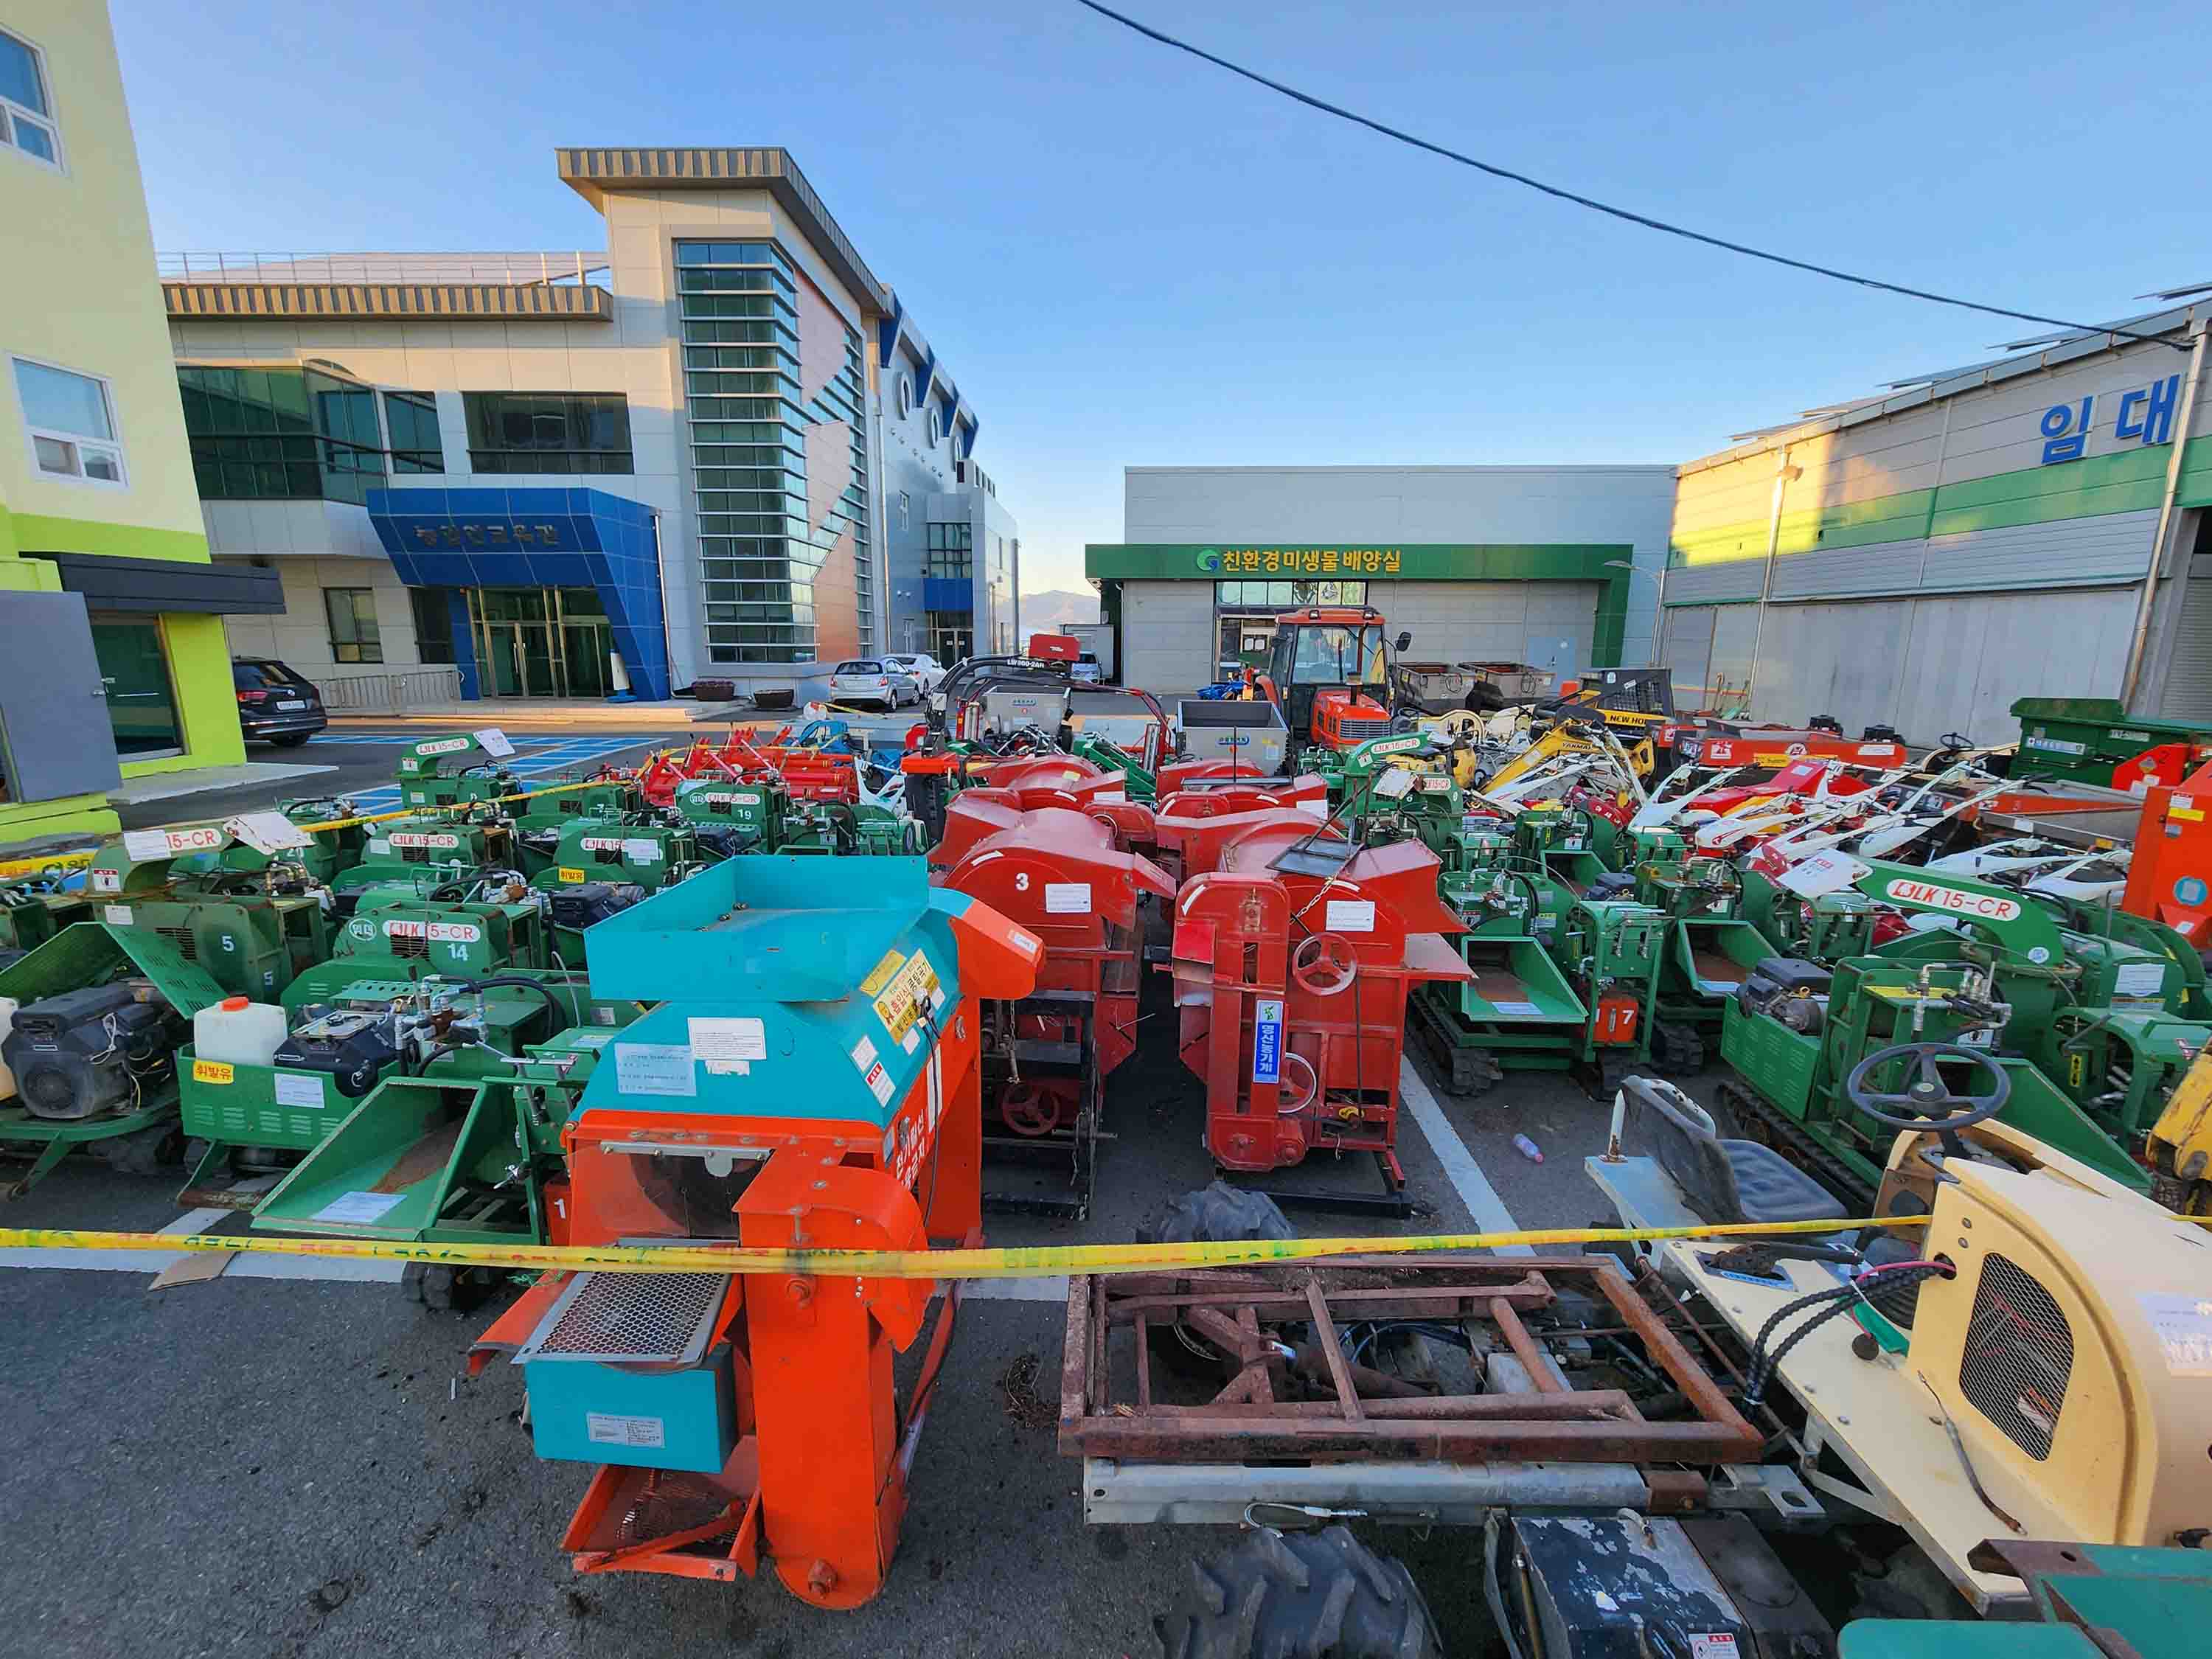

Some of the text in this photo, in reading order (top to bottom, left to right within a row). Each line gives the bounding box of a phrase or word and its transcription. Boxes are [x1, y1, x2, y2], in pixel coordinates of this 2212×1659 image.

[2041, 374, 2180, 465] 임대
[1223, 550, 1401, 572] 친환경 미생물 배양실
[1610, 714, 1630, 723] NEW
[737, 809, 751, 820] 19
[166, 831, 217, 849] 15-CR
[1015, 872, 1029, 891] 3
[1941, 890, 2011, 918] 15-CR
[222, 935, 234, 952] 5
[448, 943, 469, 961] 14
[197, 1064, 231, 1080] 휘발유
[554, 1198, 566, 1219] 1
